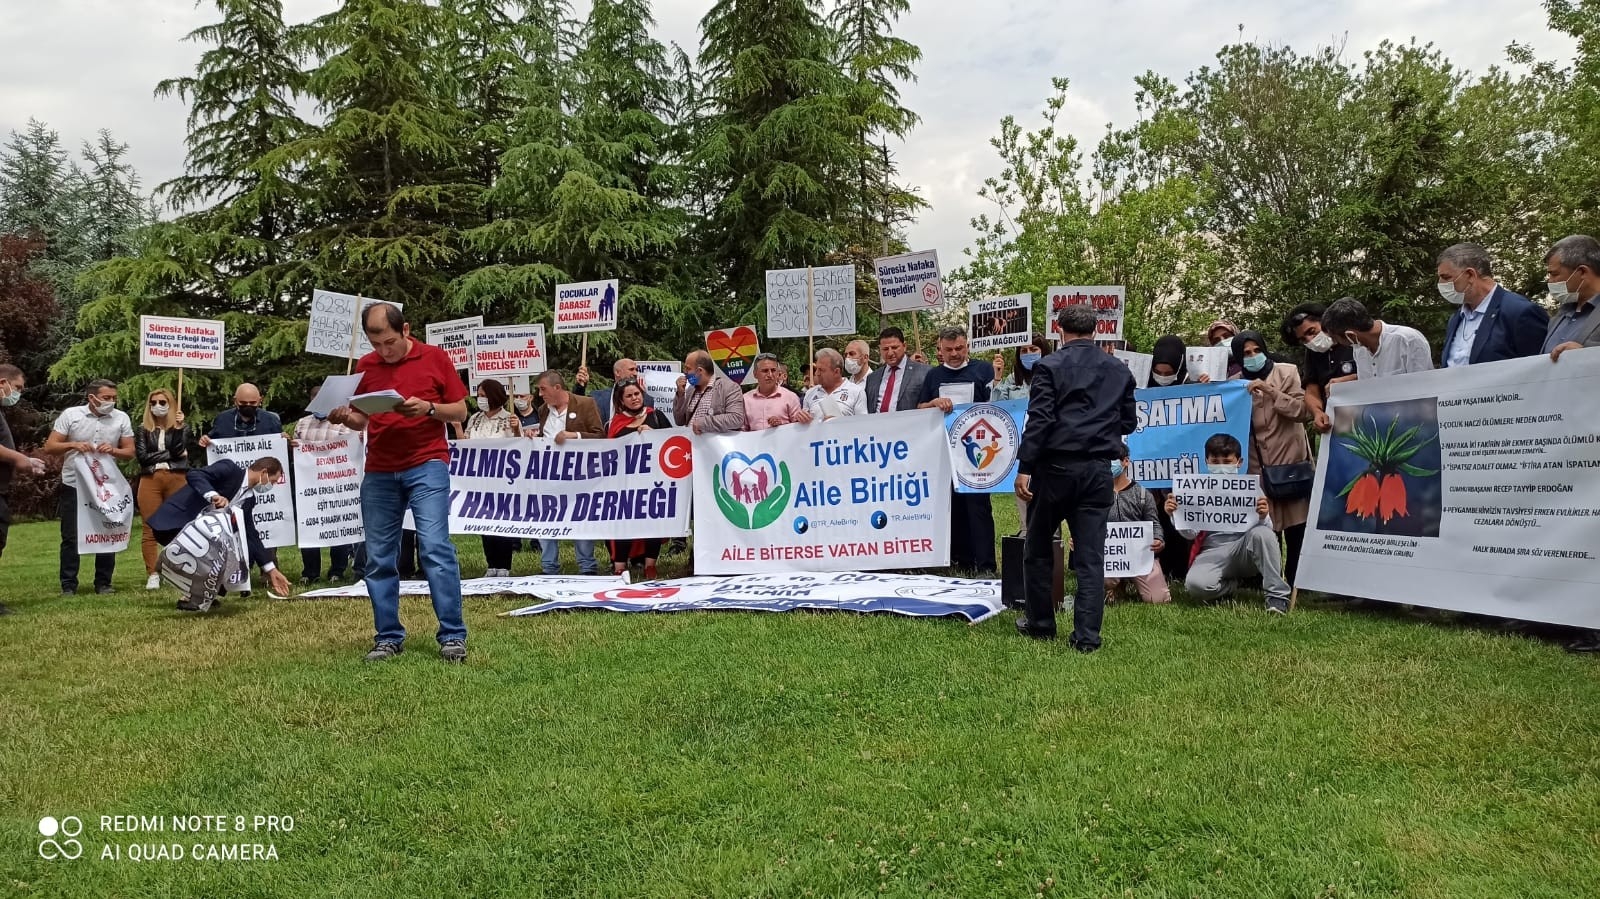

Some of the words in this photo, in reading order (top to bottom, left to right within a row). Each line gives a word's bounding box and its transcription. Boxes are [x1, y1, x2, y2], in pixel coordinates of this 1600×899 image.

[878, 264, 906, 276] Süresiz
[908, 260, 935, 272] Nafaka
[560, 288, 598, 301] ÇOCUKLAR
[882, 284, 916, 297] Engeldir!
[316, 295, 351, 316] 6284
[560, 300, 591, 310] BABASIZ
[978, 300, 996, 312] TACİZ
[998, 298, 1020, 308] DEĞİL
[1090, 295, 1118, 309] YOK!
[558, 311, 597, 322] KALMASIN
[149, 324, 182, 334] Süresiz
[185, 327, 215, 336] Nafaka
[1096, 319, 1118, 334] OK!
[178, 334, 199, 343] Erkeği
[202, 336, 218, 345] Değil
[444, 334, 464, 342] İNSAN
[992, 334, 1028, 346] MAĞDURU
[150, 348, 184, 358] Mağdur
[186, 351, 216, 360] ediyor!
[448, 348, 466, 356] YKIRI
[476, 349, 505, 360] SÜRELİ
[508, 350, 540, 358] NAFAKA
[478, 359, 516, 370] MECLİSE
[518, 360, 528, 368] !!!
[1136, 394, 1226, 433] ŞATMA
[234, 440, 256, 453] İFTİRA
[258, 438, 272, 450] AİLE
[1535, 438, 1562, 447] BAŞINDA
[1564, 434, 1594, 444] ÖLÜMLÜ
[336, 454, 348, 464] ESAS
[810, 436, 908, 469] Türkiye
[449, 442, 521, 485] ĞILMIŞ
[525, 446, 619, 481] AİLELER
[625, 443, 652, 475] VE
[319, 486, 334, 495] ERKEK
[344, 482, 360, 492] KADIN
[1176, 476, 1218, 490] TAYYİP
[1222, 478, 1256, 490] DEDE
[1514, 484, 1536, 492] TAYYİP
[1538, 484, 1573, 492] ERDOĞAN
[794, 480, 842, 508] Aile
[850, 472, 930, 507] Birliği
[458, 490, 568, 522] HAKLARI
[570, 481, 677, 522] DERNEĞİ
[1176, 493, 1194, 506] BİZ
[1198, 496, 1256, 507] BABAMIZI
[253, 511, 284, 525] ÇSUZLAR
[306, 518, 320, 526] 6284
[343, 515, 358, 524] KADIN
[1184, 509, 1248, 524] İSTİYORUZ
[320, 529, 340, 540] MODELİ
[463, 523, 572, 538] www.tudacder.org.tr
[721, 545, 755, 561] AİLE
[760, 544, 824, 560] BİTERSE
[830, 542, 878, 556] VATAN
[884, 536, 933, 554] BİTER
[1490, 546, 1516, 554] BURADA
[1105, 559, 1130, 571] ERİN
